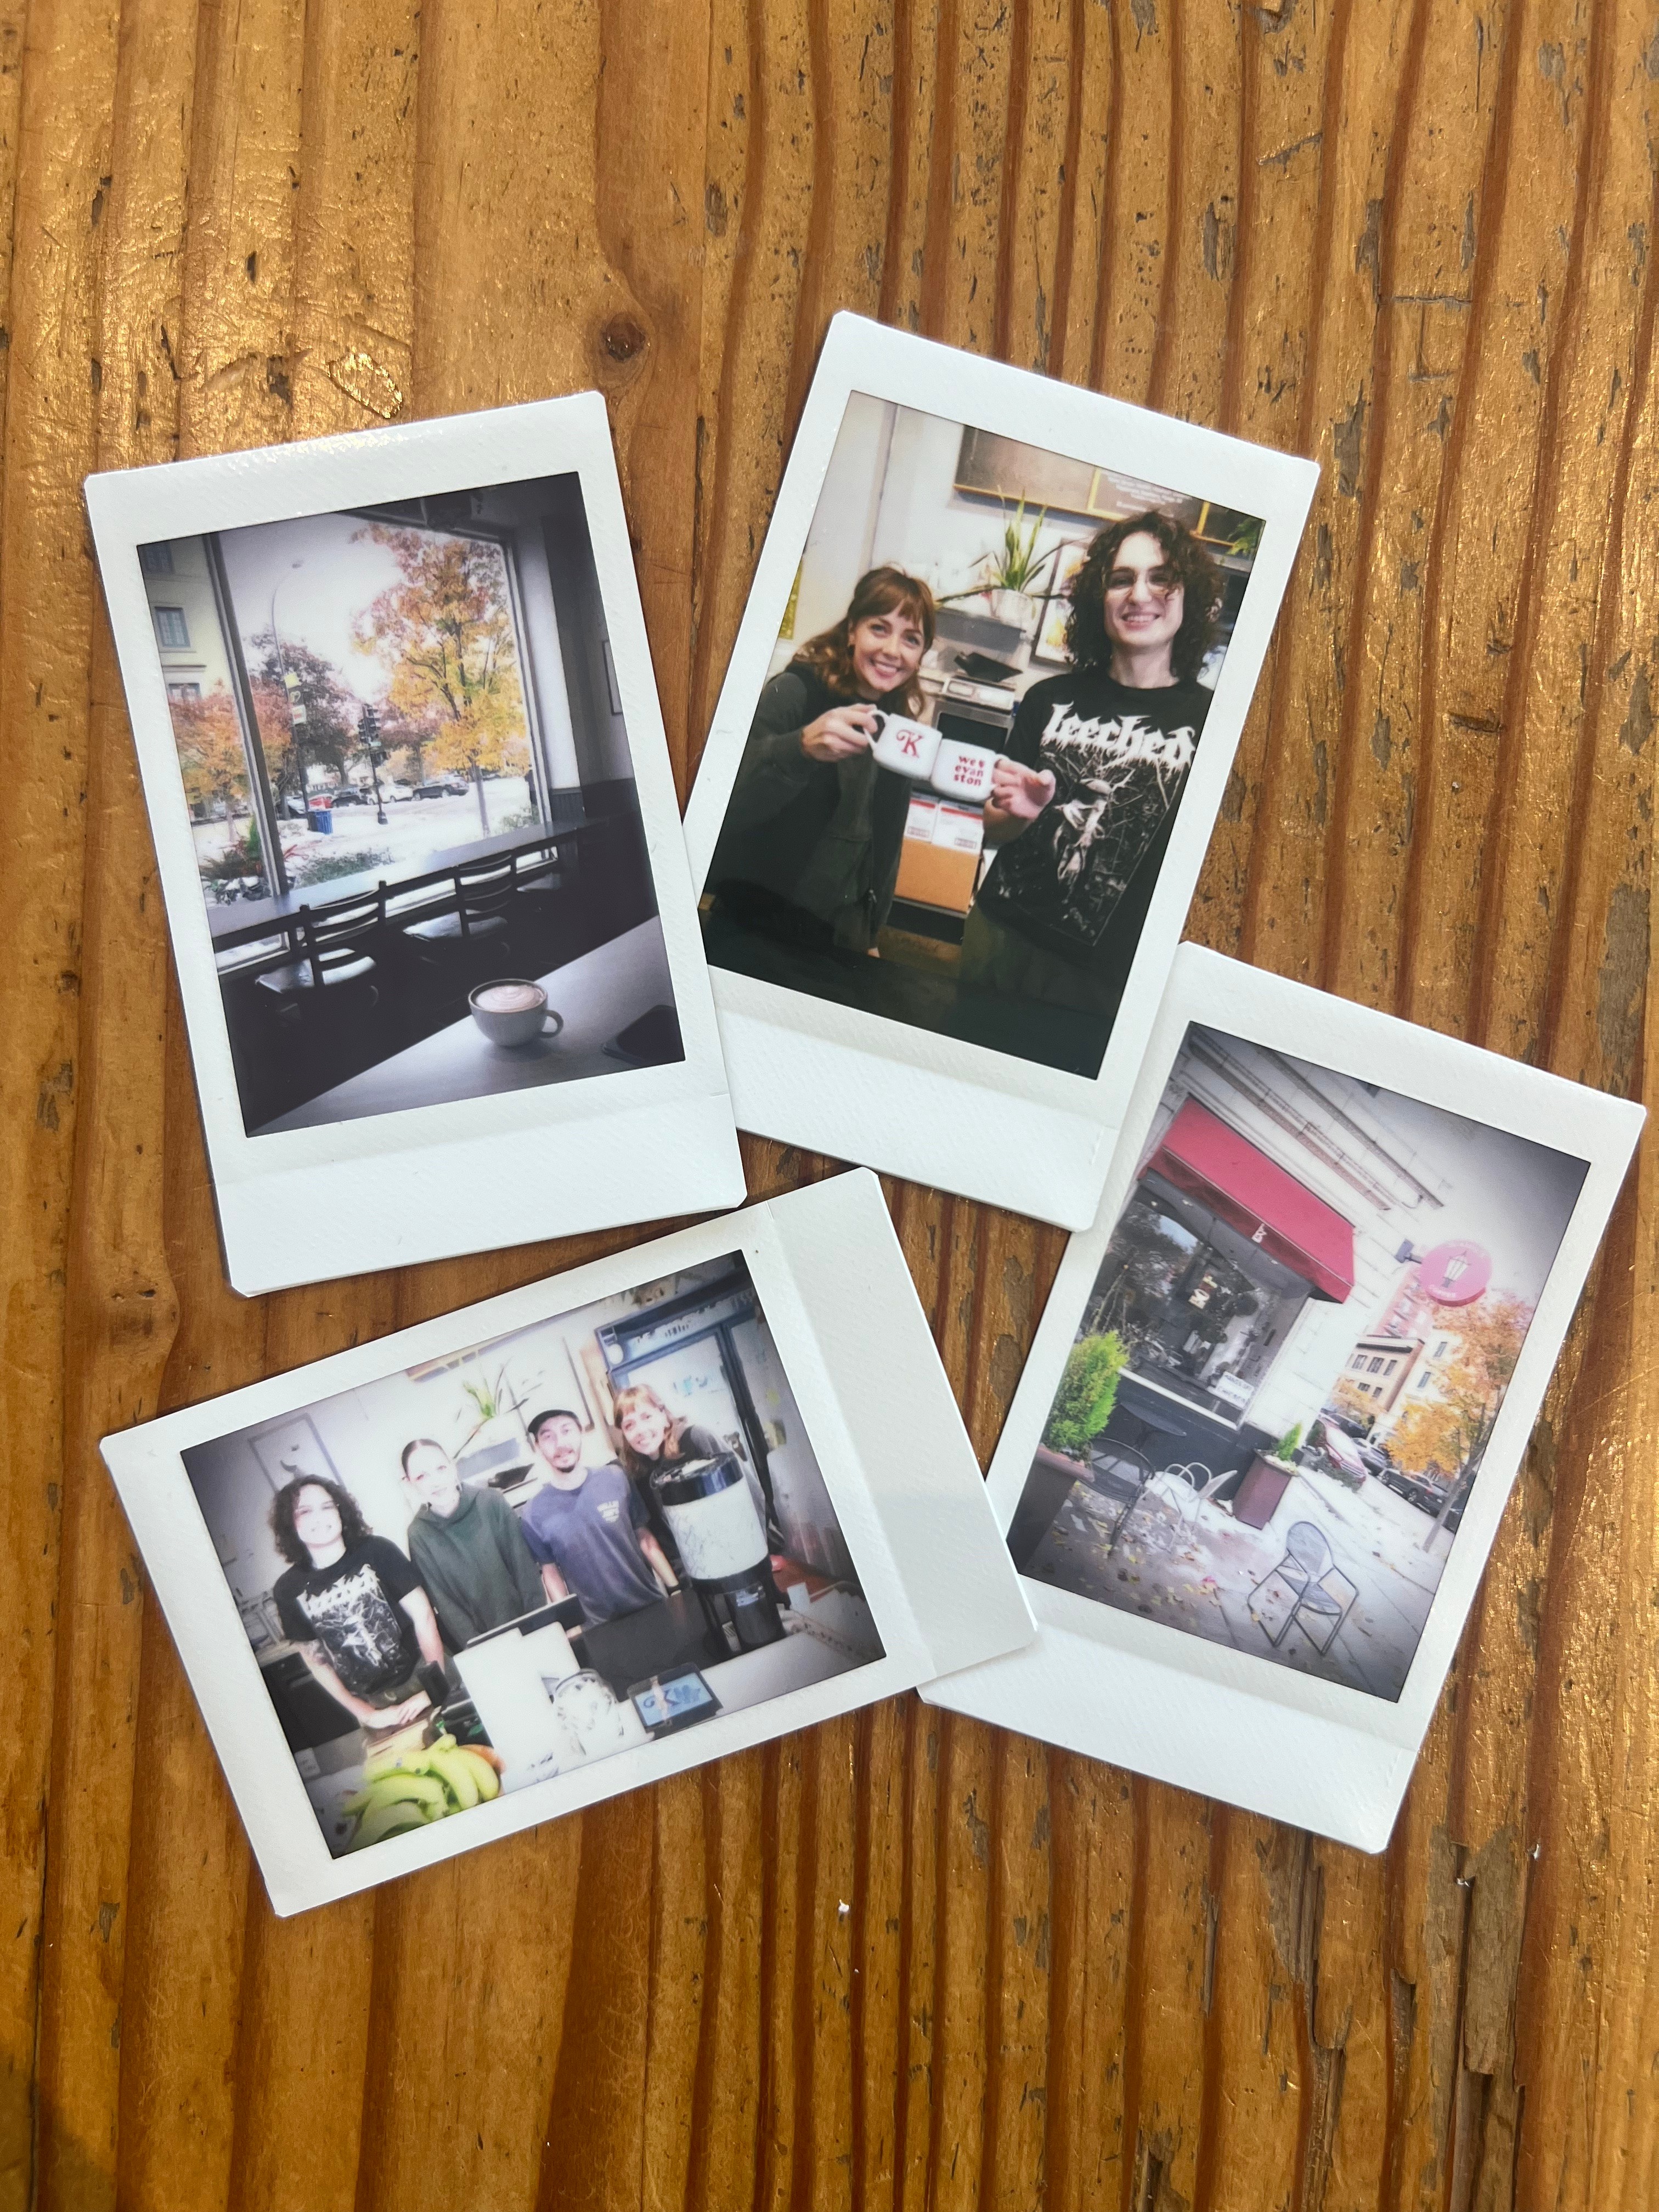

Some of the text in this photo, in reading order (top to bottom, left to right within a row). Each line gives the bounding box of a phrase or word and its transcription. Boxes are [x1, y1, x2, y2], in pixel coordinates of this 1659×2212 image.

[896, 729, 924, 758] K
[955, 765, 984, 777] evan
[953, 774, 981, 786] ston
